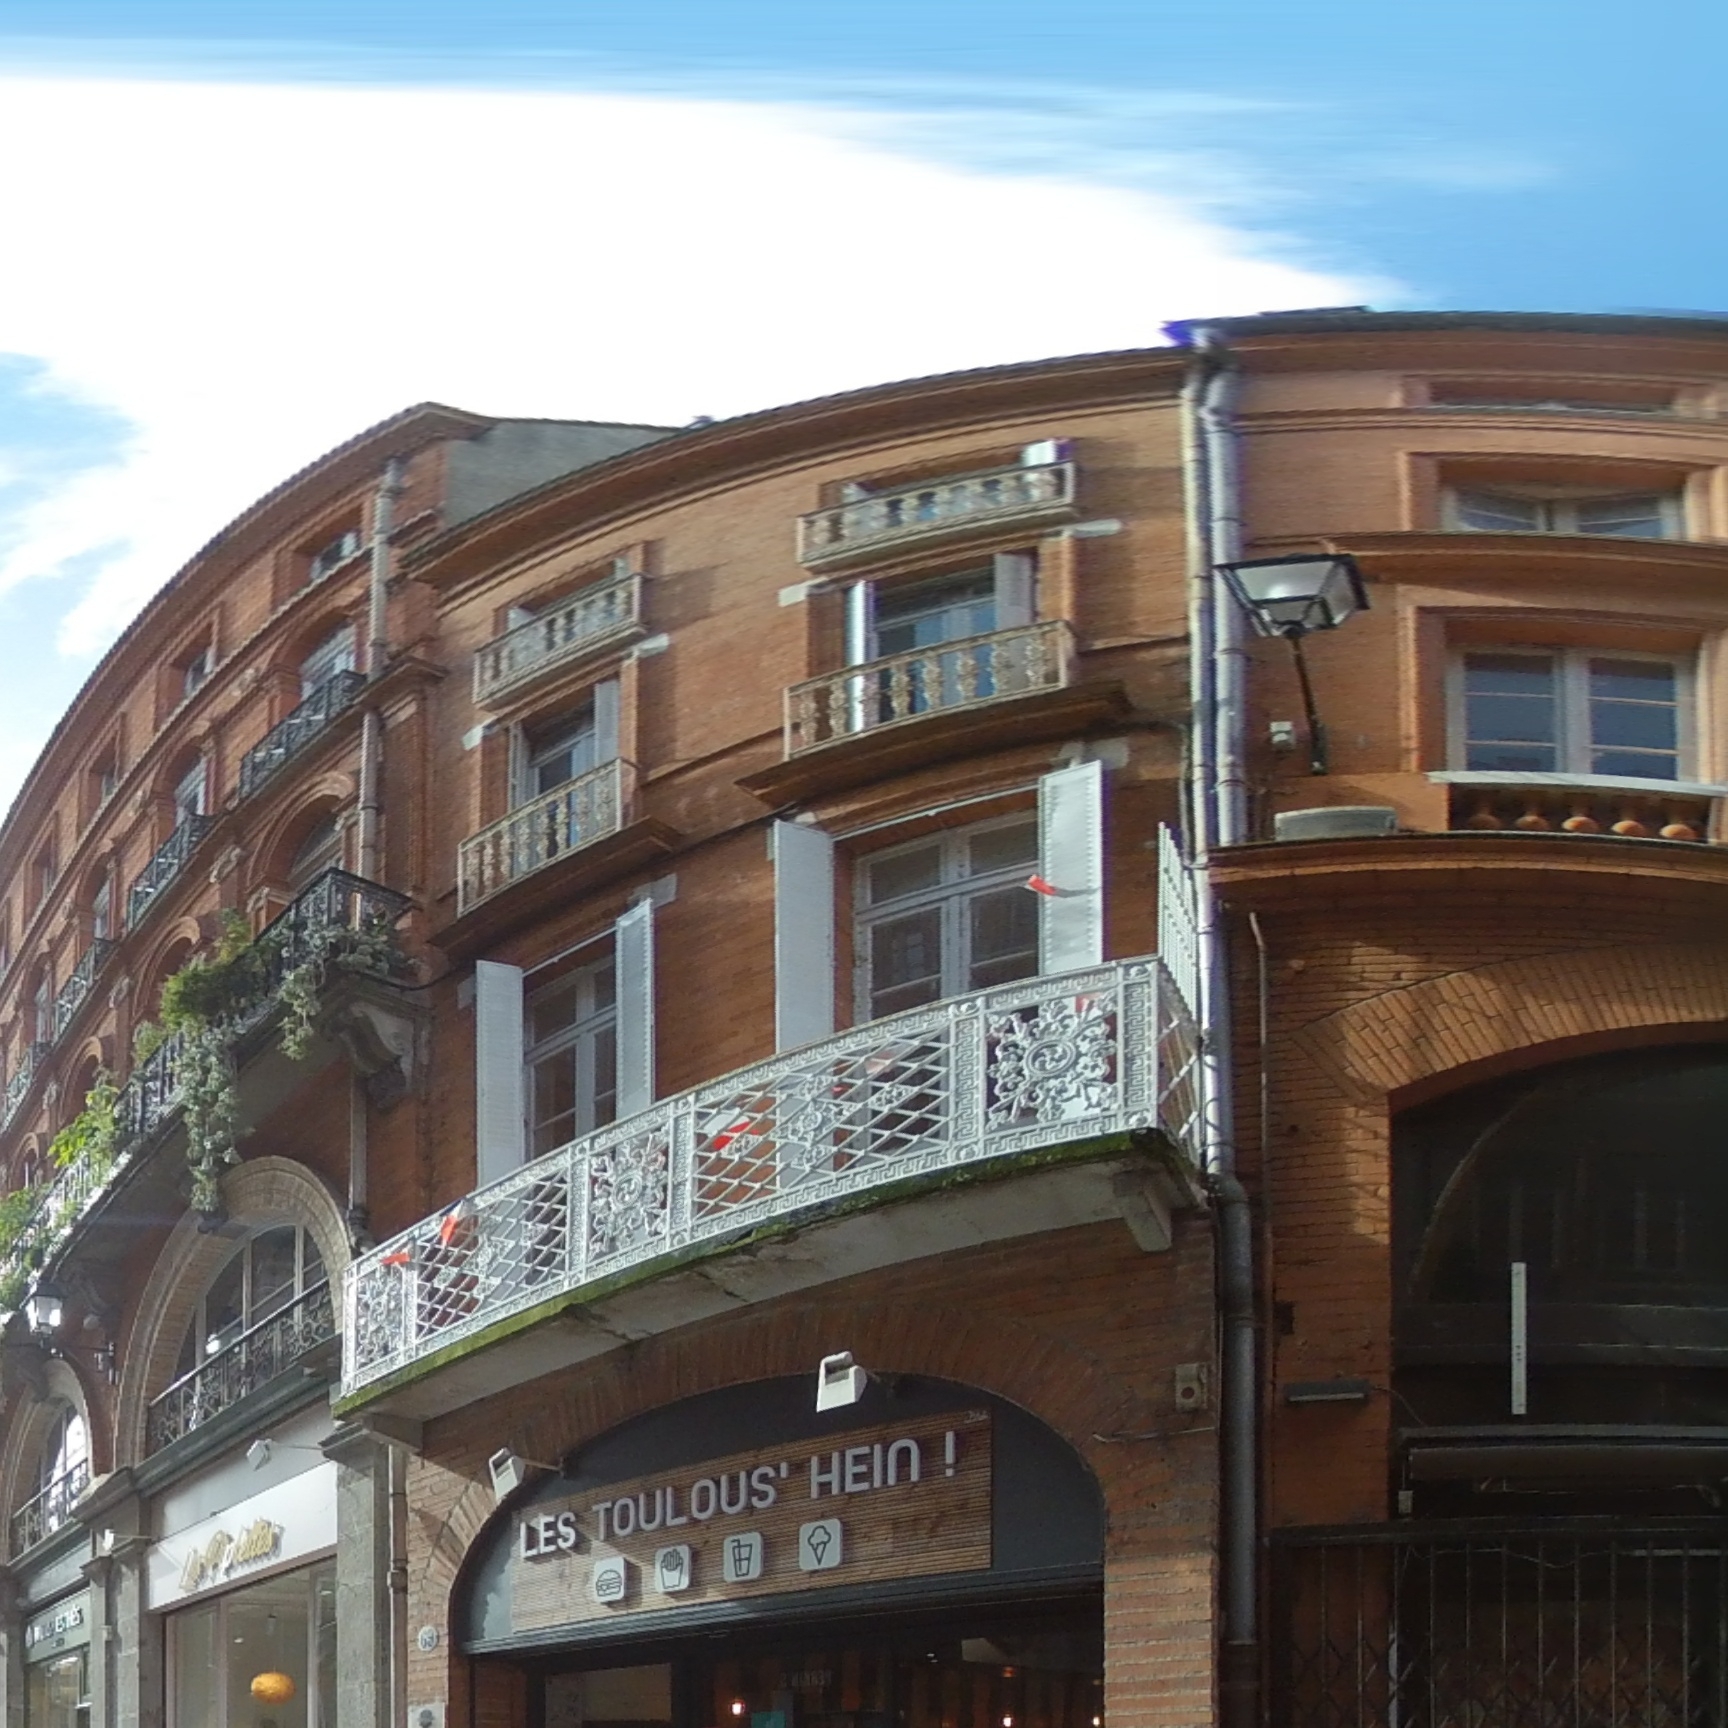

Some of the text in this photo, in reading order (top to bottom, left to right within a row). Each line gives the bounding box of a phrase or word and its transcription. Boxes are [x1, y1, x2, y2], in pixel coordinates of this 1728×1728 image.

[519, 1511, 576, 1558] LES
[592, 1461, 789, 1542] TOULOUS'
[945, 1430, 956, 1477] !
